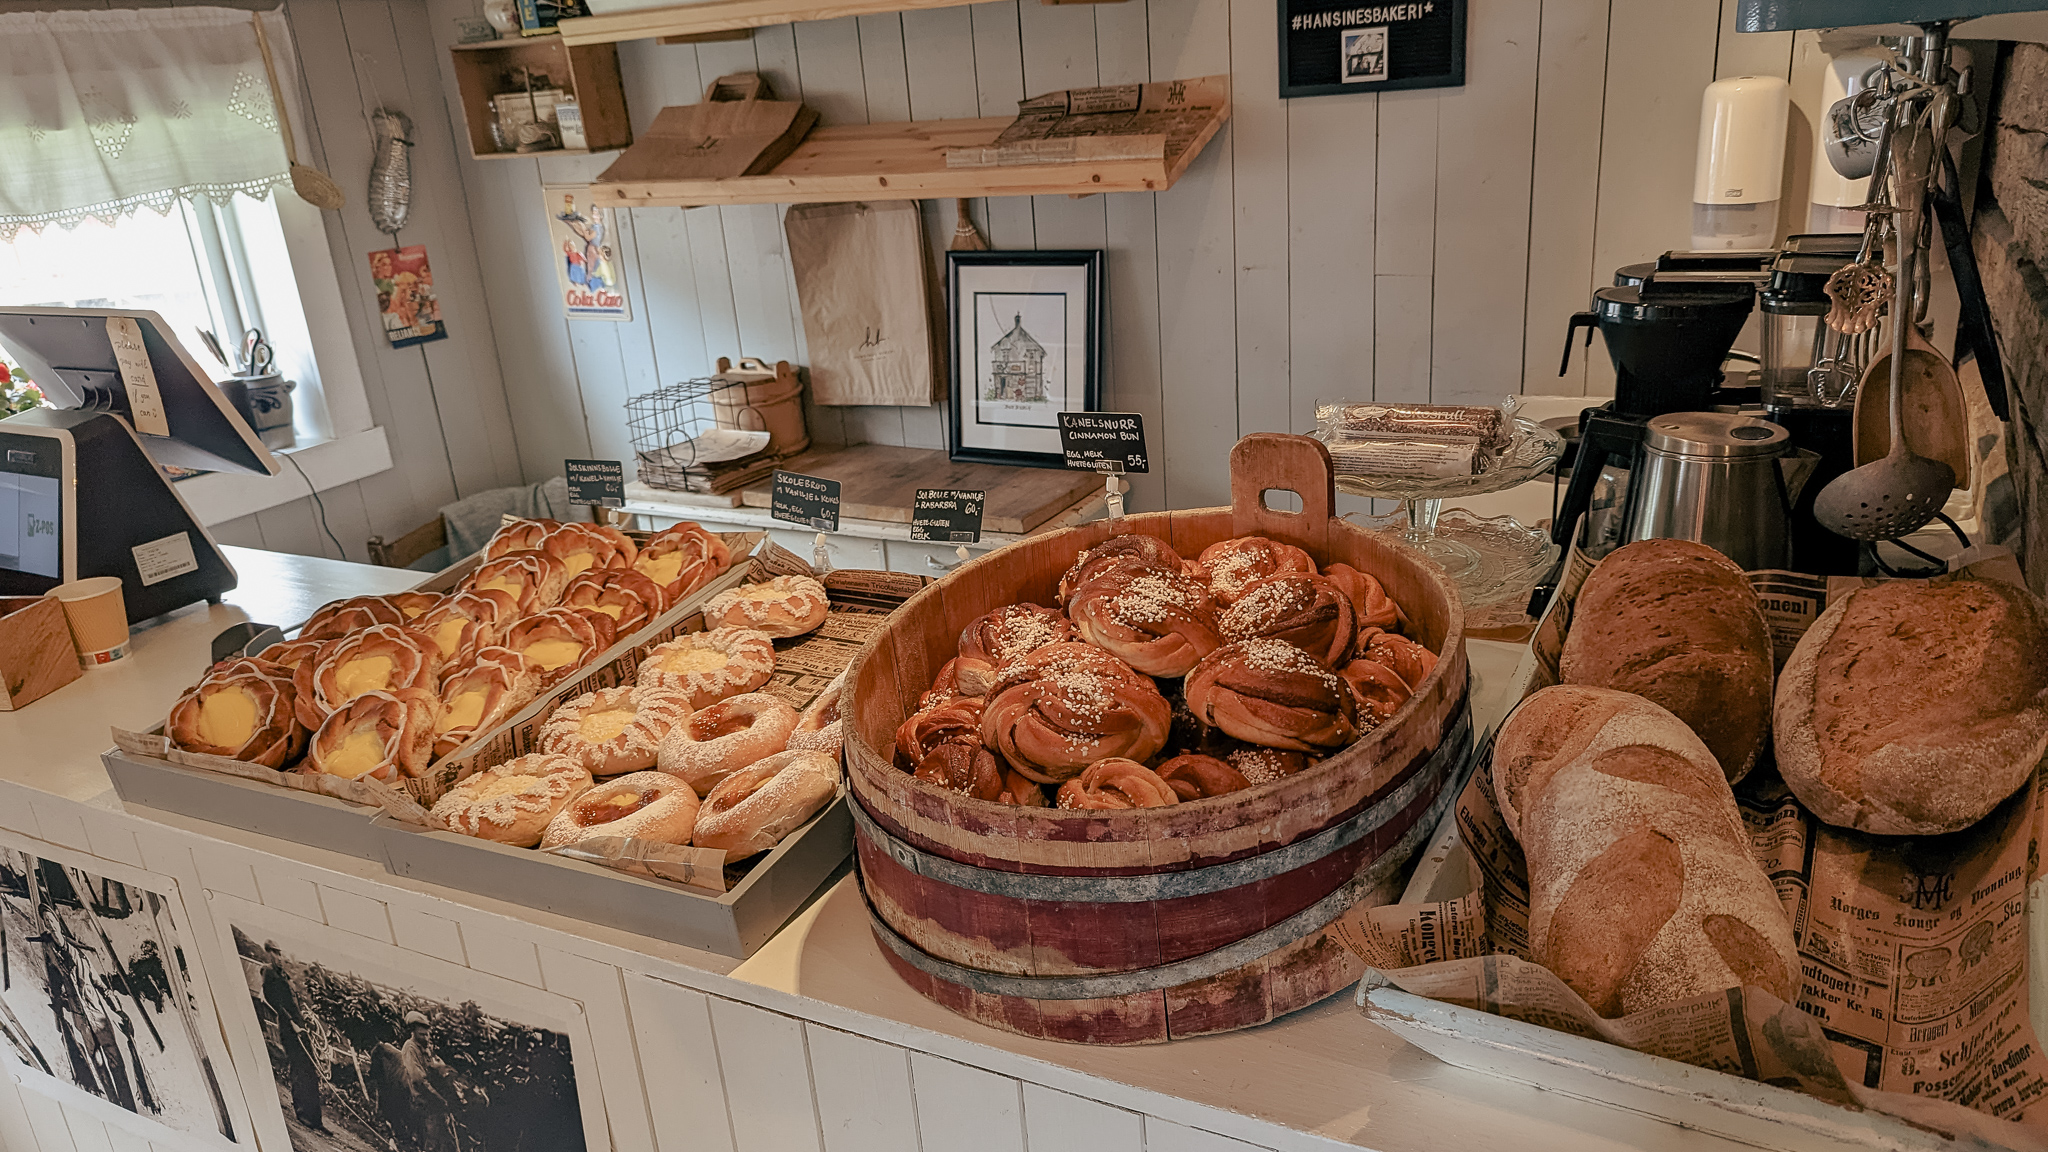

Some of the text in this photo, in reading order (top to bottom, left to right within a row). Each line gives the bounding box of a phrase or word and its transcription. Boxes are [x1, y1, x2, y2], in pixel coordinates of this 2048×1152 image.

[1063, 415, 1137, 430] KANELSNURR
[1069, 431, 1140, 441] CINNAMON BUN
[1066, 449, 1104, 459] EGG, MELK
[1127, 454, 1147, 469] 55,-
[920, 501, 957, 511] RABARBRA
